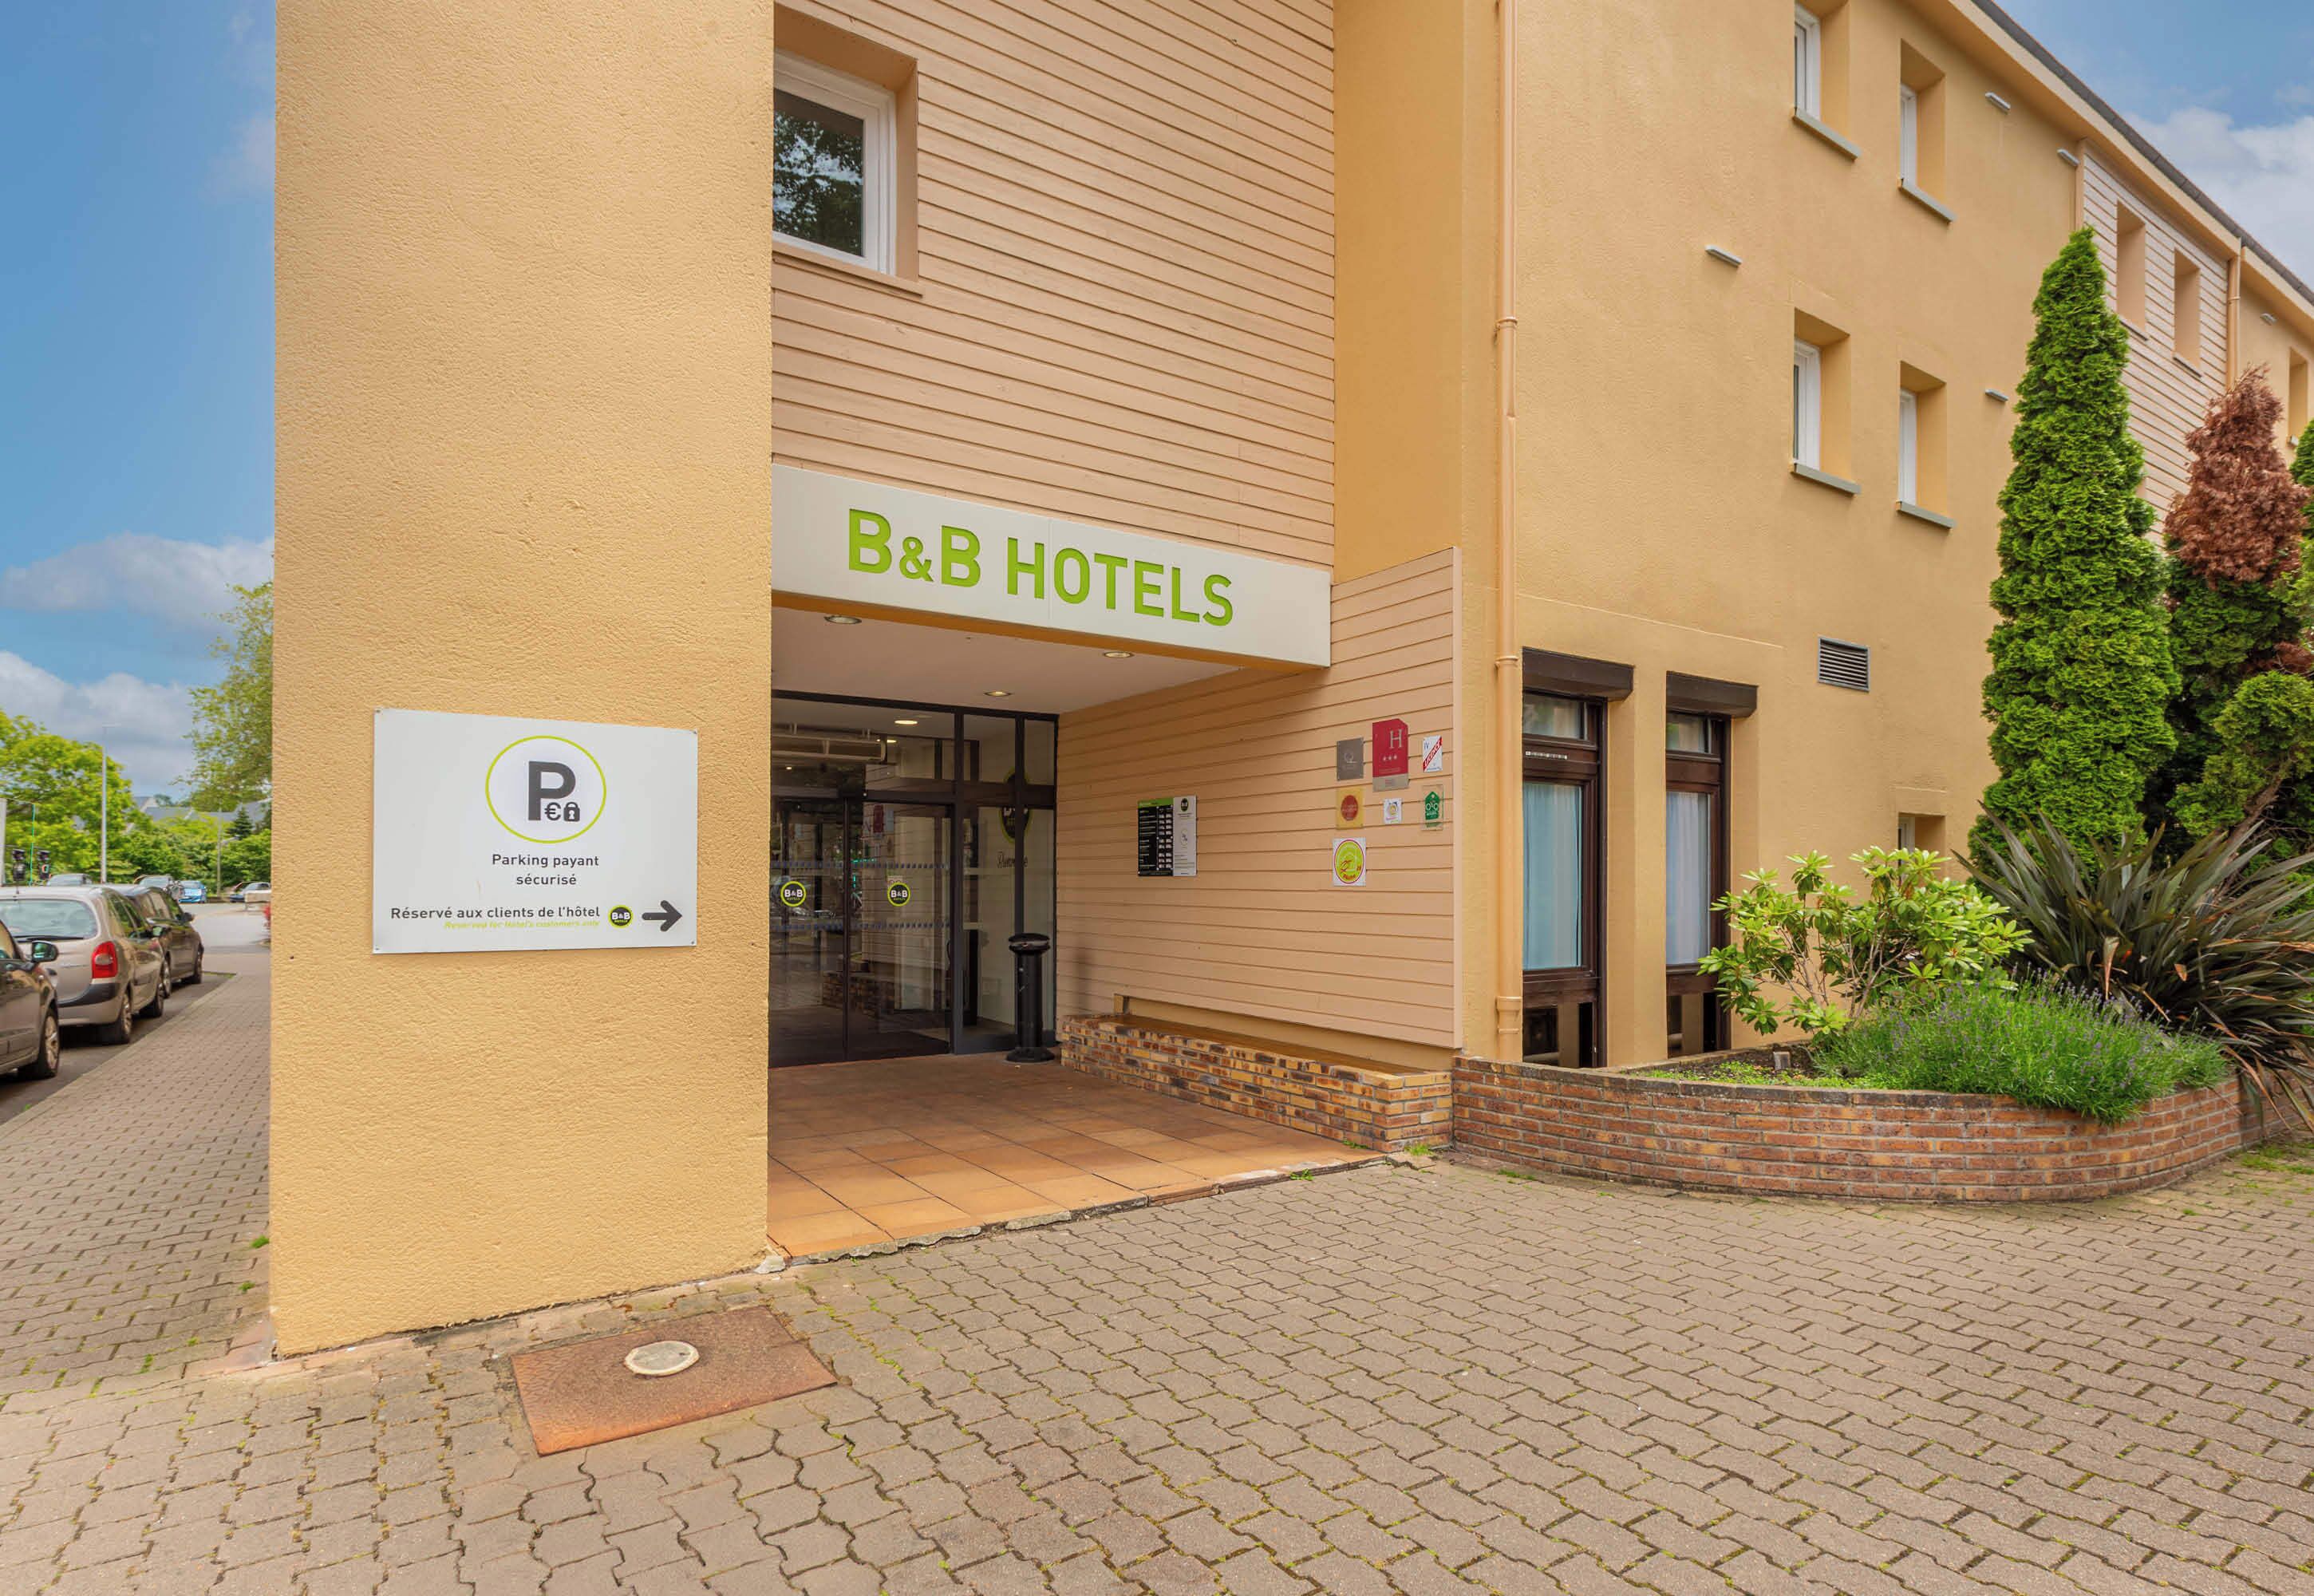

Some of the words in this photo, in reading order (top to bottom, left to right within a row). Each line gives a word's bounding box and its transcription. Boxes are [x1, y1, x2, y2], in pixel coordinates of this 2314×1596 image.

[849, 508, 981, 587] B&B
[1007, 536, 1234, 626] HOTELS
[1389, 728, 1403, 749] H
[528, 760, 576, 821] P
[492, 854, 548, 868] Parking
[553, 855, 599, 868] payant
[516, 873, 577, 885] sécurisé
[784, 889, 804, 898] B&B
[391, 907, 452, 918] Réservé
[487, 907, 535, 918] clients
[538, 907, 555, 918] de
[559, 906, 600, 917] l'hôtel
